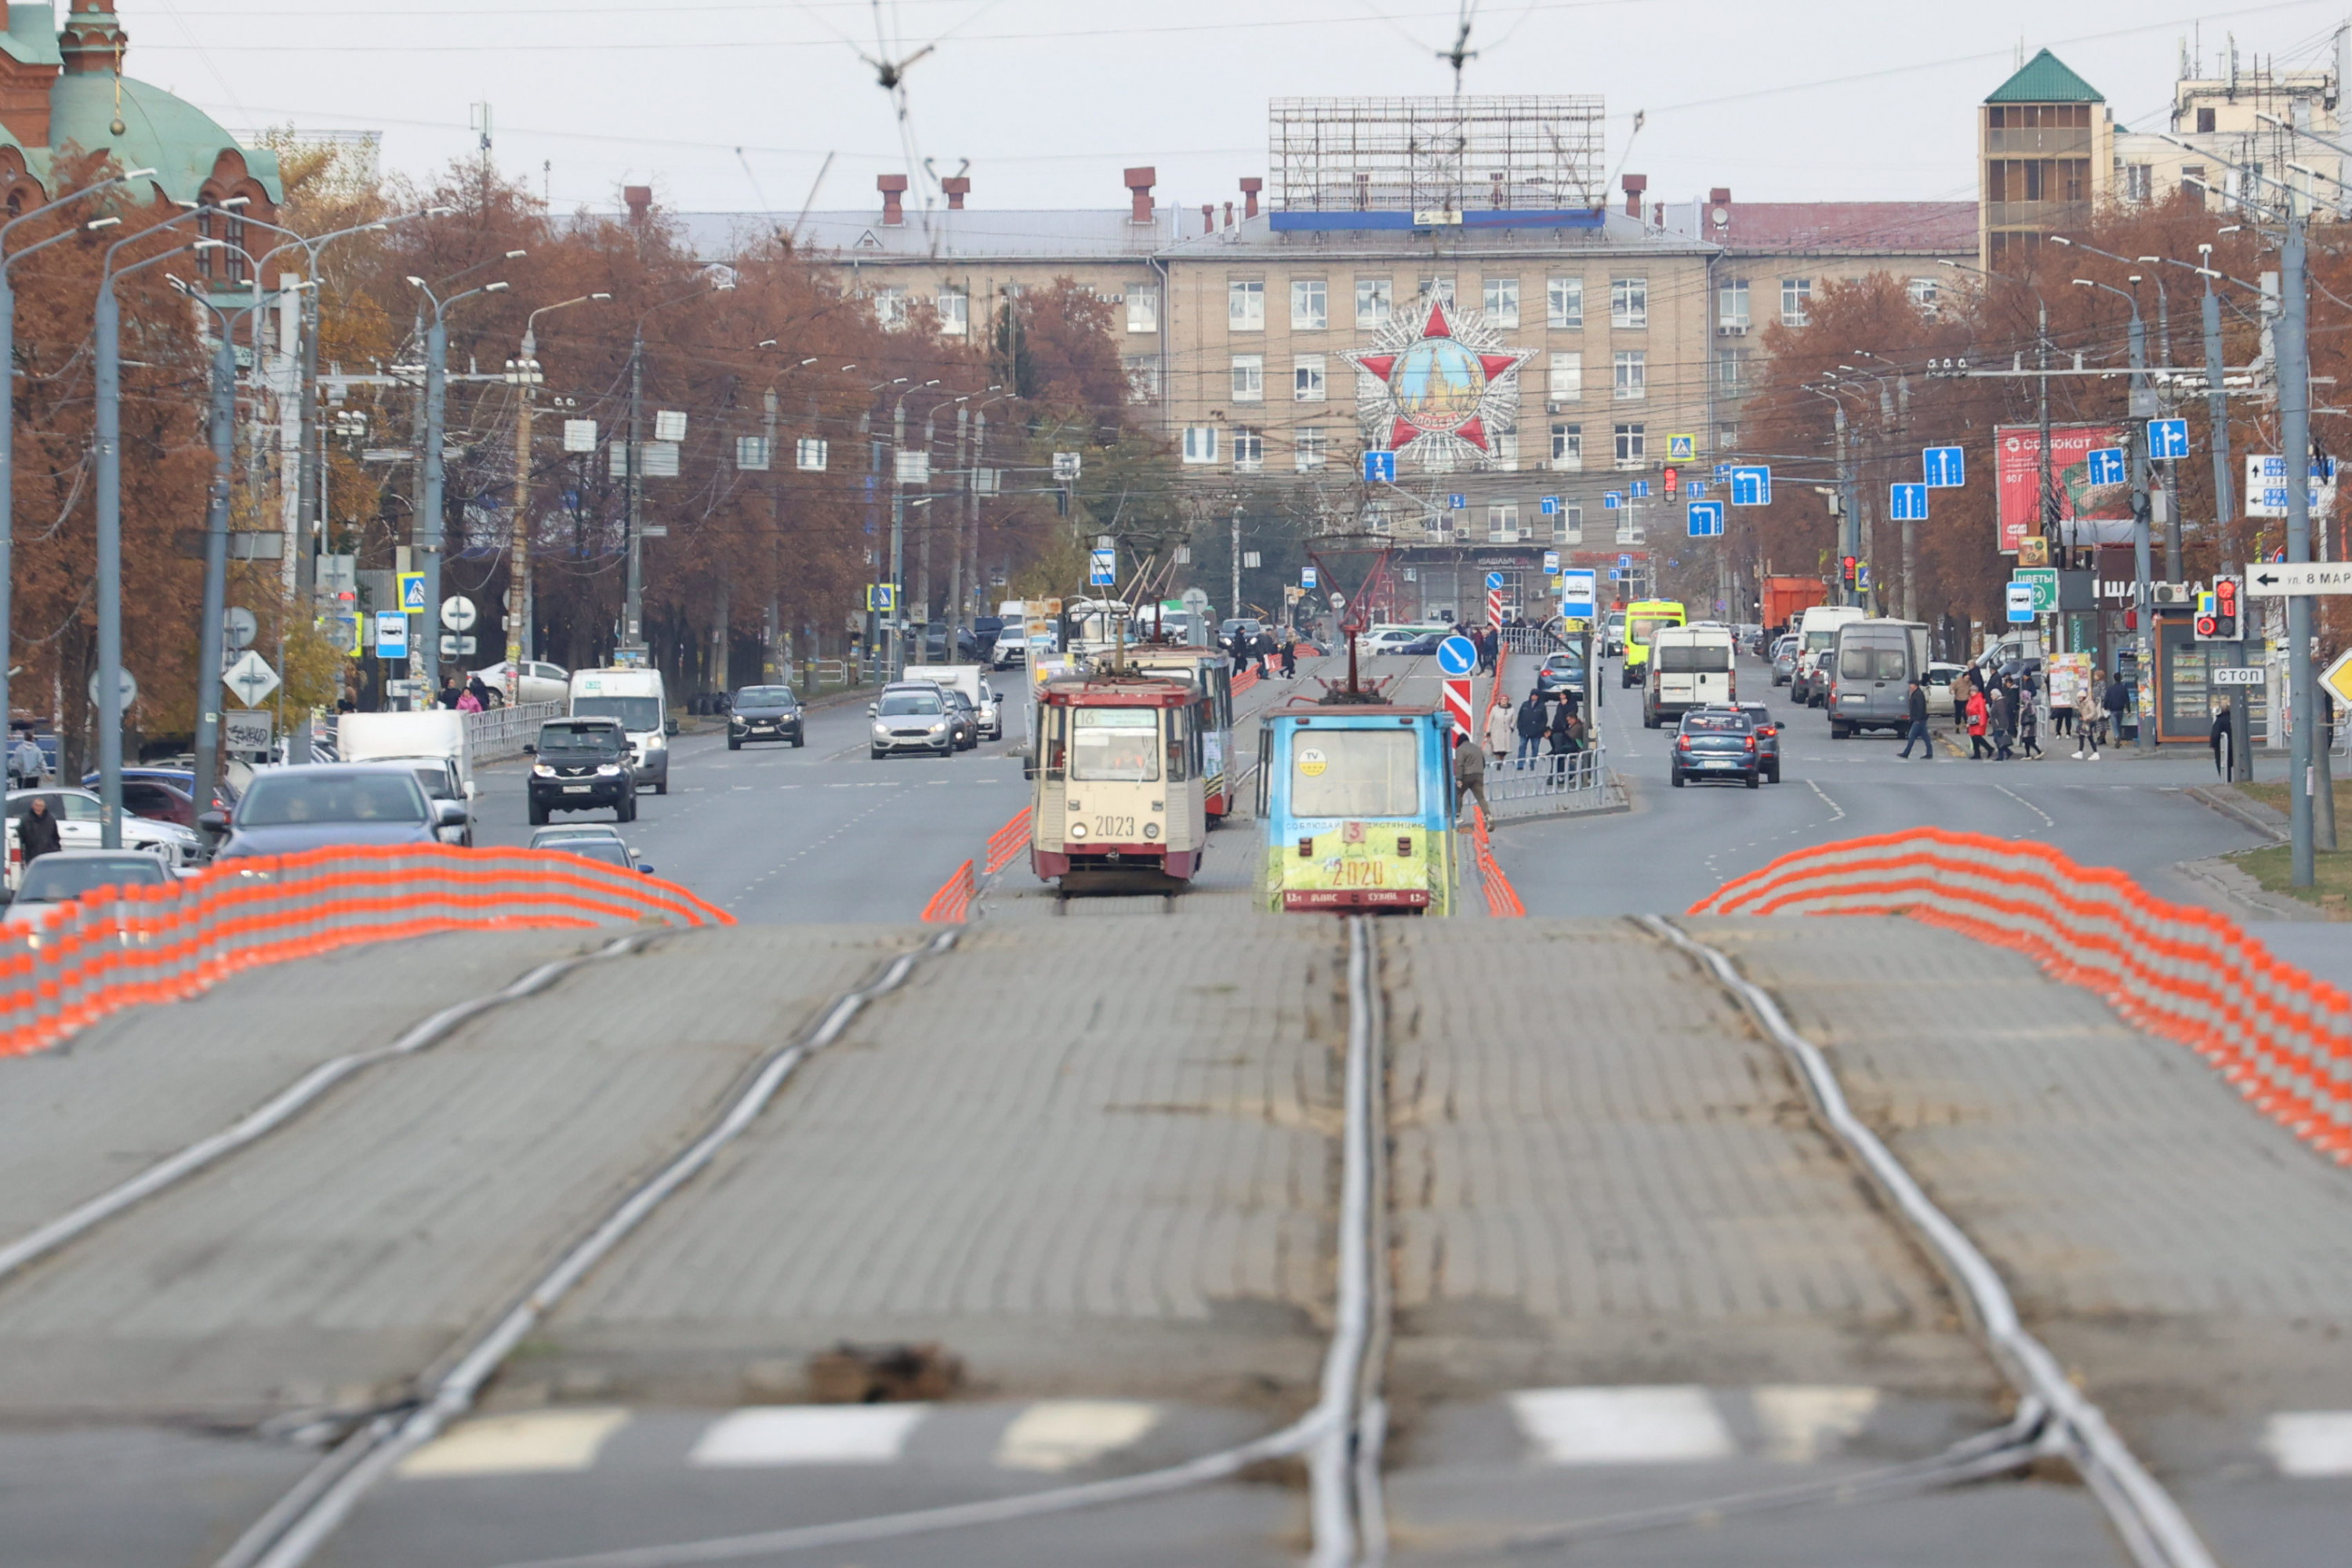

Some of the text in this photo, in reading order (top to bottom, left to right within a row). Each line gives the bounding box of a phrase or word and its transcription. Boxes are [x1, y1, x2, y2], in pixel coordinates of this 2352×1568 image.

[2307, 573, 2314, 584] 8
[2219, 670, 2259, 681] СТОП
[1081, 710, 1094, 724] 16
[1095, 815, 1134, 837] 2023
[1286, 822, 1341, 830] СОБЛЮДАЙ
[1349, 822, 1360, 839] 3
[1332, 861, 1383, 886] 2020
